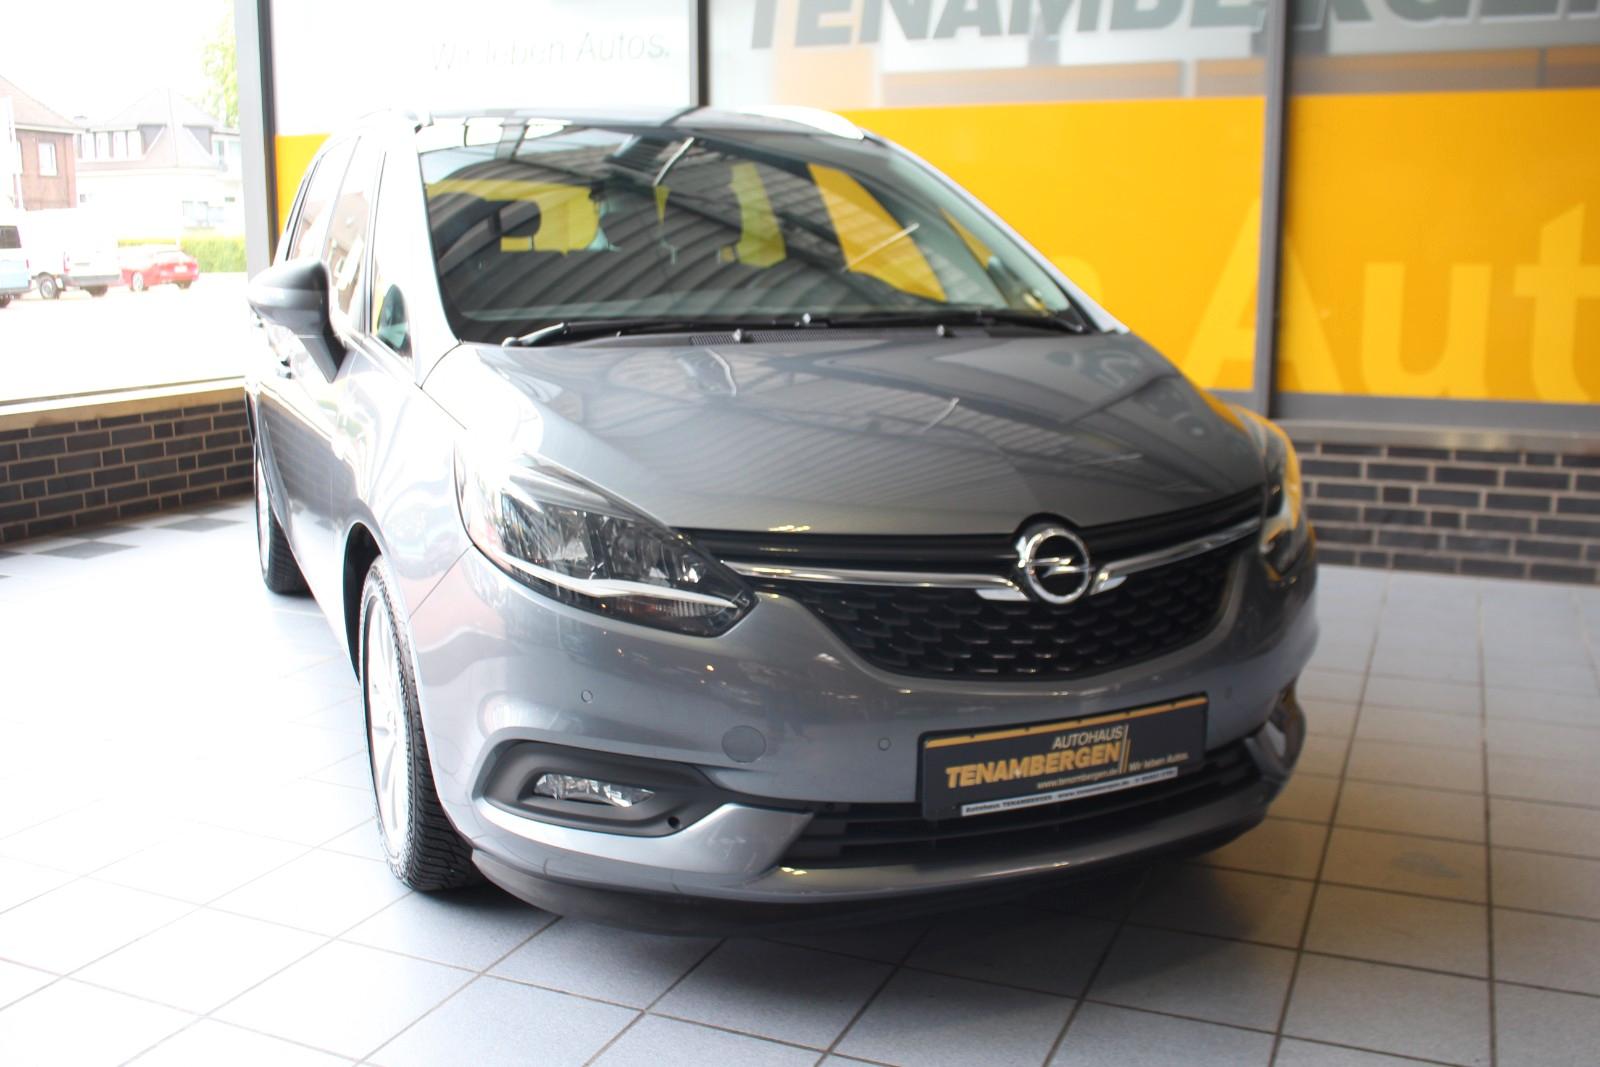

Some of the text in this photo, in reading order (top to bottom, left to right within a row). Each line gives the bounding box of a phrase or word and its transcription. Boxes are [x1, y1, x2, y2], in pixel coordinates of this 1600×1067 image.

[576, 32, 671, 63] Autos.
[1052, 725, 1123, 750] AUTOHAUS
[945, 741, 1121, 789] TENAMBERGEN
